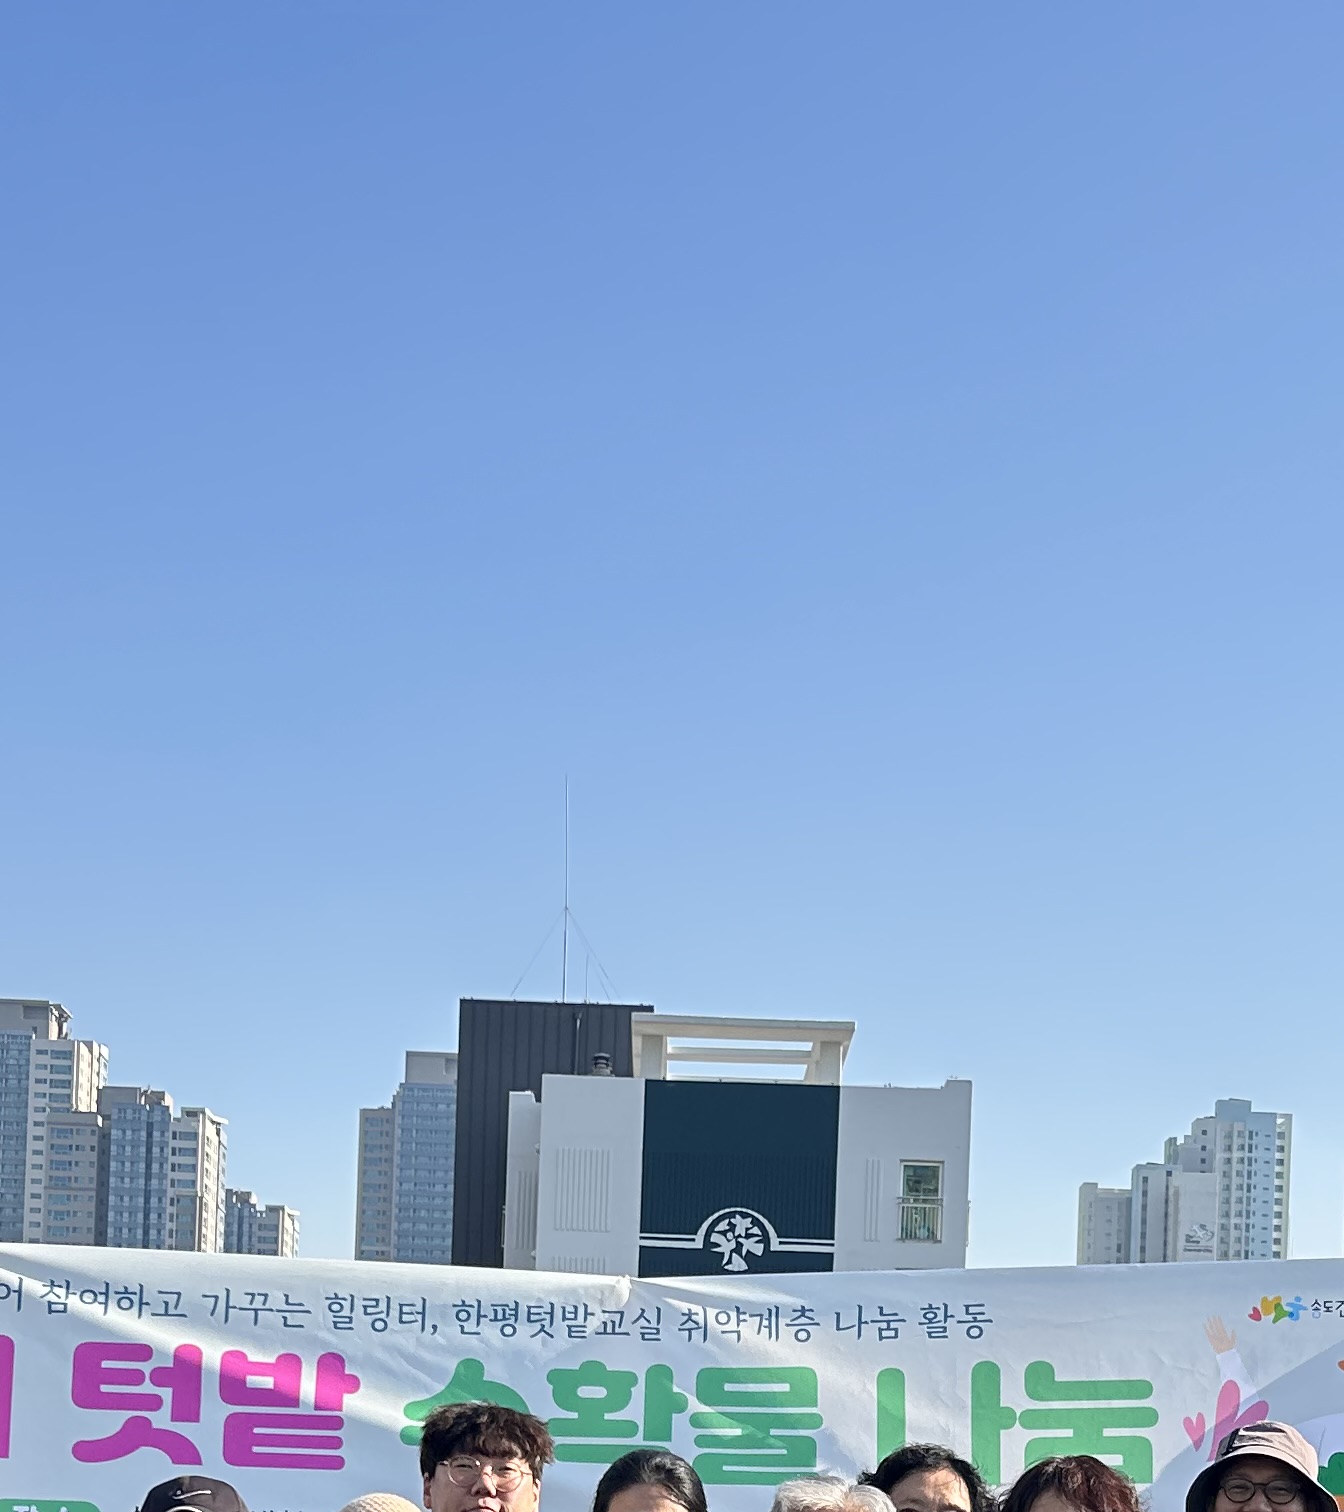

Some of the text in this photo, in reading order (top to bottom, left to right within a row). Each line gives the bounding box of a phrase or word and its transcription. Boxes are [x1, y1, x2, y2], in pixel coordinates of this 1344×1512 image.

[39, 1280, 188, 1320] 참여하고
[203, 1288, 312, 1329] 가꾸는
[327, 1293, 440, 1335] 힐링터,
[454, 1299, 662, 1342] 한평텃밭교실
[677, 1302, 819, 1344] 취약계층
[833, 1302, 907, 1341] 나눔
[918, 1301, 995, 1340] 활동
[71, 1341, 362, 1470] 텃밭
[876, 1360, 1159, 1486] 나눔
